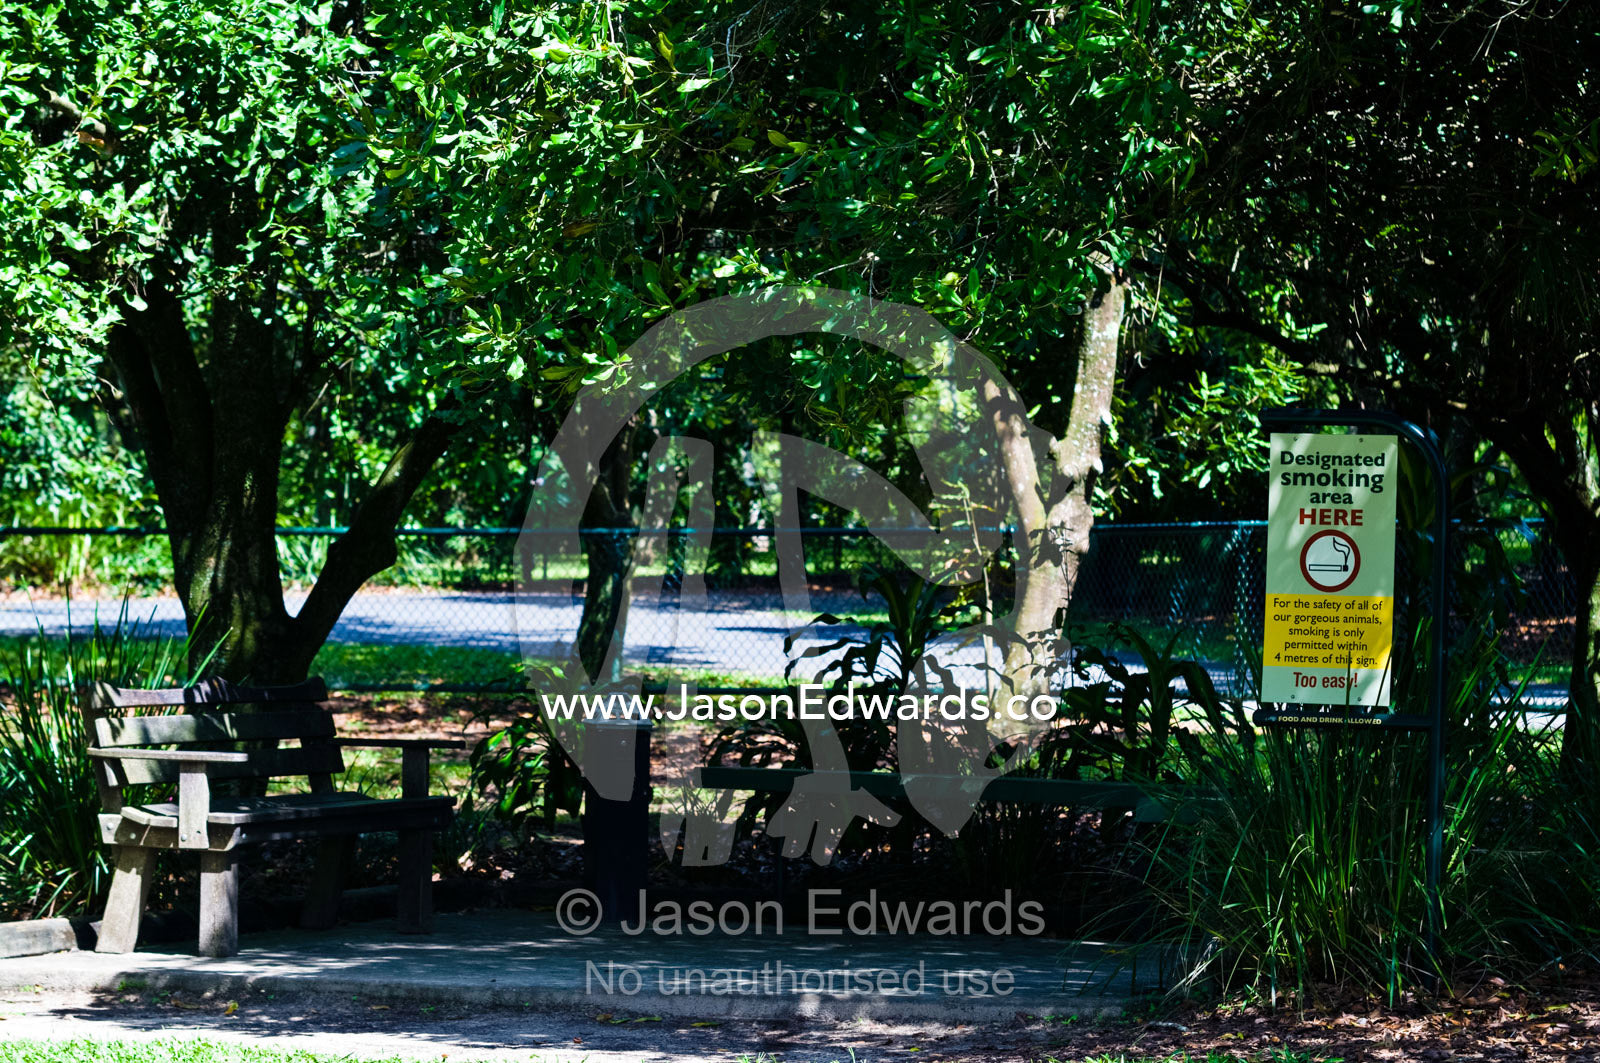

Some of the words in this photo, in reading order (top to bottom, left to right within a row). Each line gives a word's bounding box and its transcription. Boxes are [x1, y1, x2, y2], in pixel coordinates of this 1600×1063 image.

[1280, 451, 1385, 469] Designated
[1280, 469, 1384, 493] smoking
[1310, 492, 1353, 504] area
[1299, 508, 1363, 526] HERE
[1273, 598, 1291, 608] For
[1294, 598, 1310, 609] the
[1313, 599, 1341, 612] safety
[1345, 599, 1356, 610] of
[1358, 600, 1369, 610] all
[1372, 600, 1383, 611] of
[1273, 614, 1291, 622] our
[1294, 614, 1340, 624] gorgeous
[1343, 613, 1382, 625] animals,
[1289, 626, 1330, 639] smoking
[1333, 627, 1340, 637] is
[1344, 628, 1364, 640] only
[1284, 641, 1333, 651] permitted
[1337, 641, 1368, 651] within
[1274, 653, 1281, 662] 4
[1284, 655, 1319, 663] metres
[1322, 654, 1333, 664] of
[1335, 654, 1352, 664] this
[1356, 655, 1378, 667] sign.
[1293, 671, 1317, 688] Too
[1322, 672, 1358, 691] easy!
